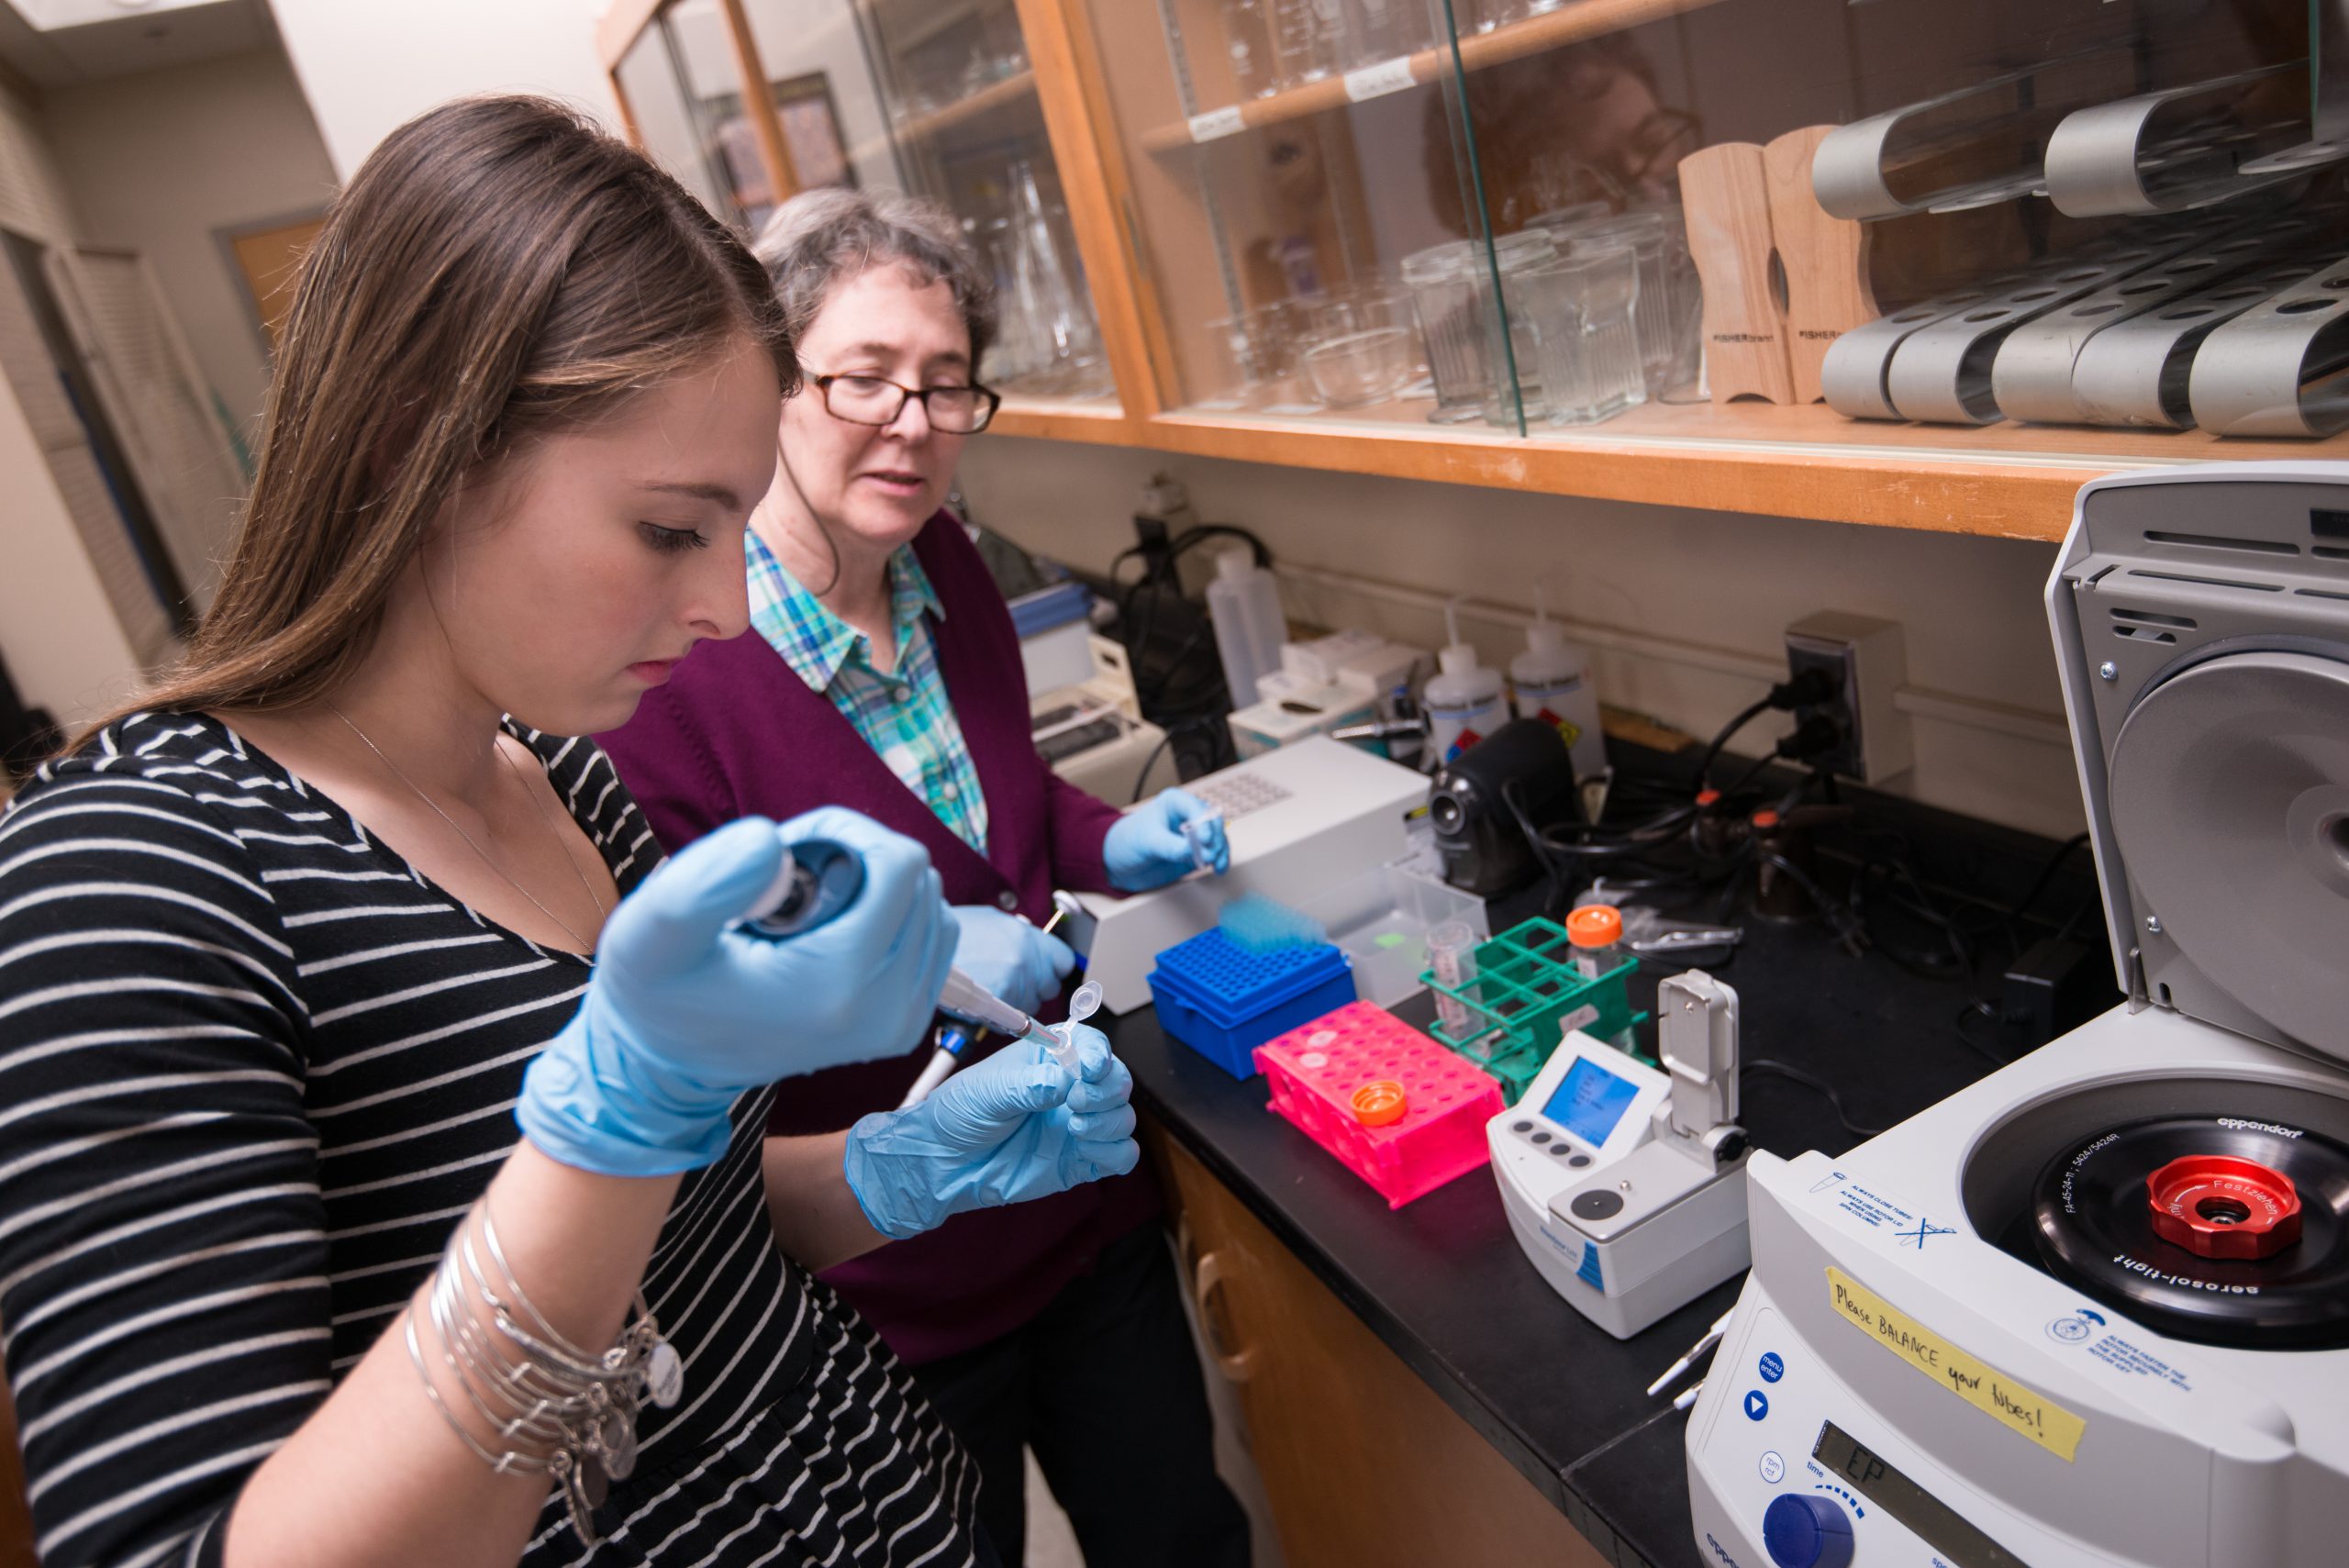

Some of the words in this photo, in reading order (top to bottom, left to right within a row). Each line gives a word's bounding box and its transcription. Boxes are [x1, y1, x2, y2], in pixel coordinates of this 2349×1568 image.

[2217, 1117, 2305, 1140] eppendorf
[2061, 1171, 2076, 1214] FA-45-24-11
[2072, 1133, 2121, 1166] 5424/5424R
[1839, 1202, 1852, 1212] SPIN
[1840, 1190, 1863, 1204] ALWAYS
[1862, 1201, 1874, 1210] USE
[1875, 1208, 1893, 1221] ROTOR
[1893, 1218, 1903, 1227] LID
[1852, 1184, 1874, 1199] ALWAYS
[1874, 1196, 1892, 1209] CLOSE
[1893, 1206, 1913, 1220] TUBES!
[2213, 1180, 2278, 1215] Festziehen
[1849, 1201, 1864, 1212] WHEN
[1865, 1210, 1881, 1222] USING
[2113, 1253, 2260, 1295] aerosol-tight
[2108, 1334, 2138, 1352] ALWAYS
[1760, 1362, 1779, 1380] enter
[1763, 1354, 1783, 1373] menu
[1835, 1283, 1873, 1325] Please
[1878, 1314, 1939, 1367] BALANCE
[1948, 1366, 1982, 1392] your
[1992, 1383, 2044, 1438] tubes!
[1765, 1456, 1781, 1472] rpm
[1765, 1465, 1776, 1478] rcf
[1807, 1461, 1824, 1479] time
[1846, 1444, 1886, 1484] EP
